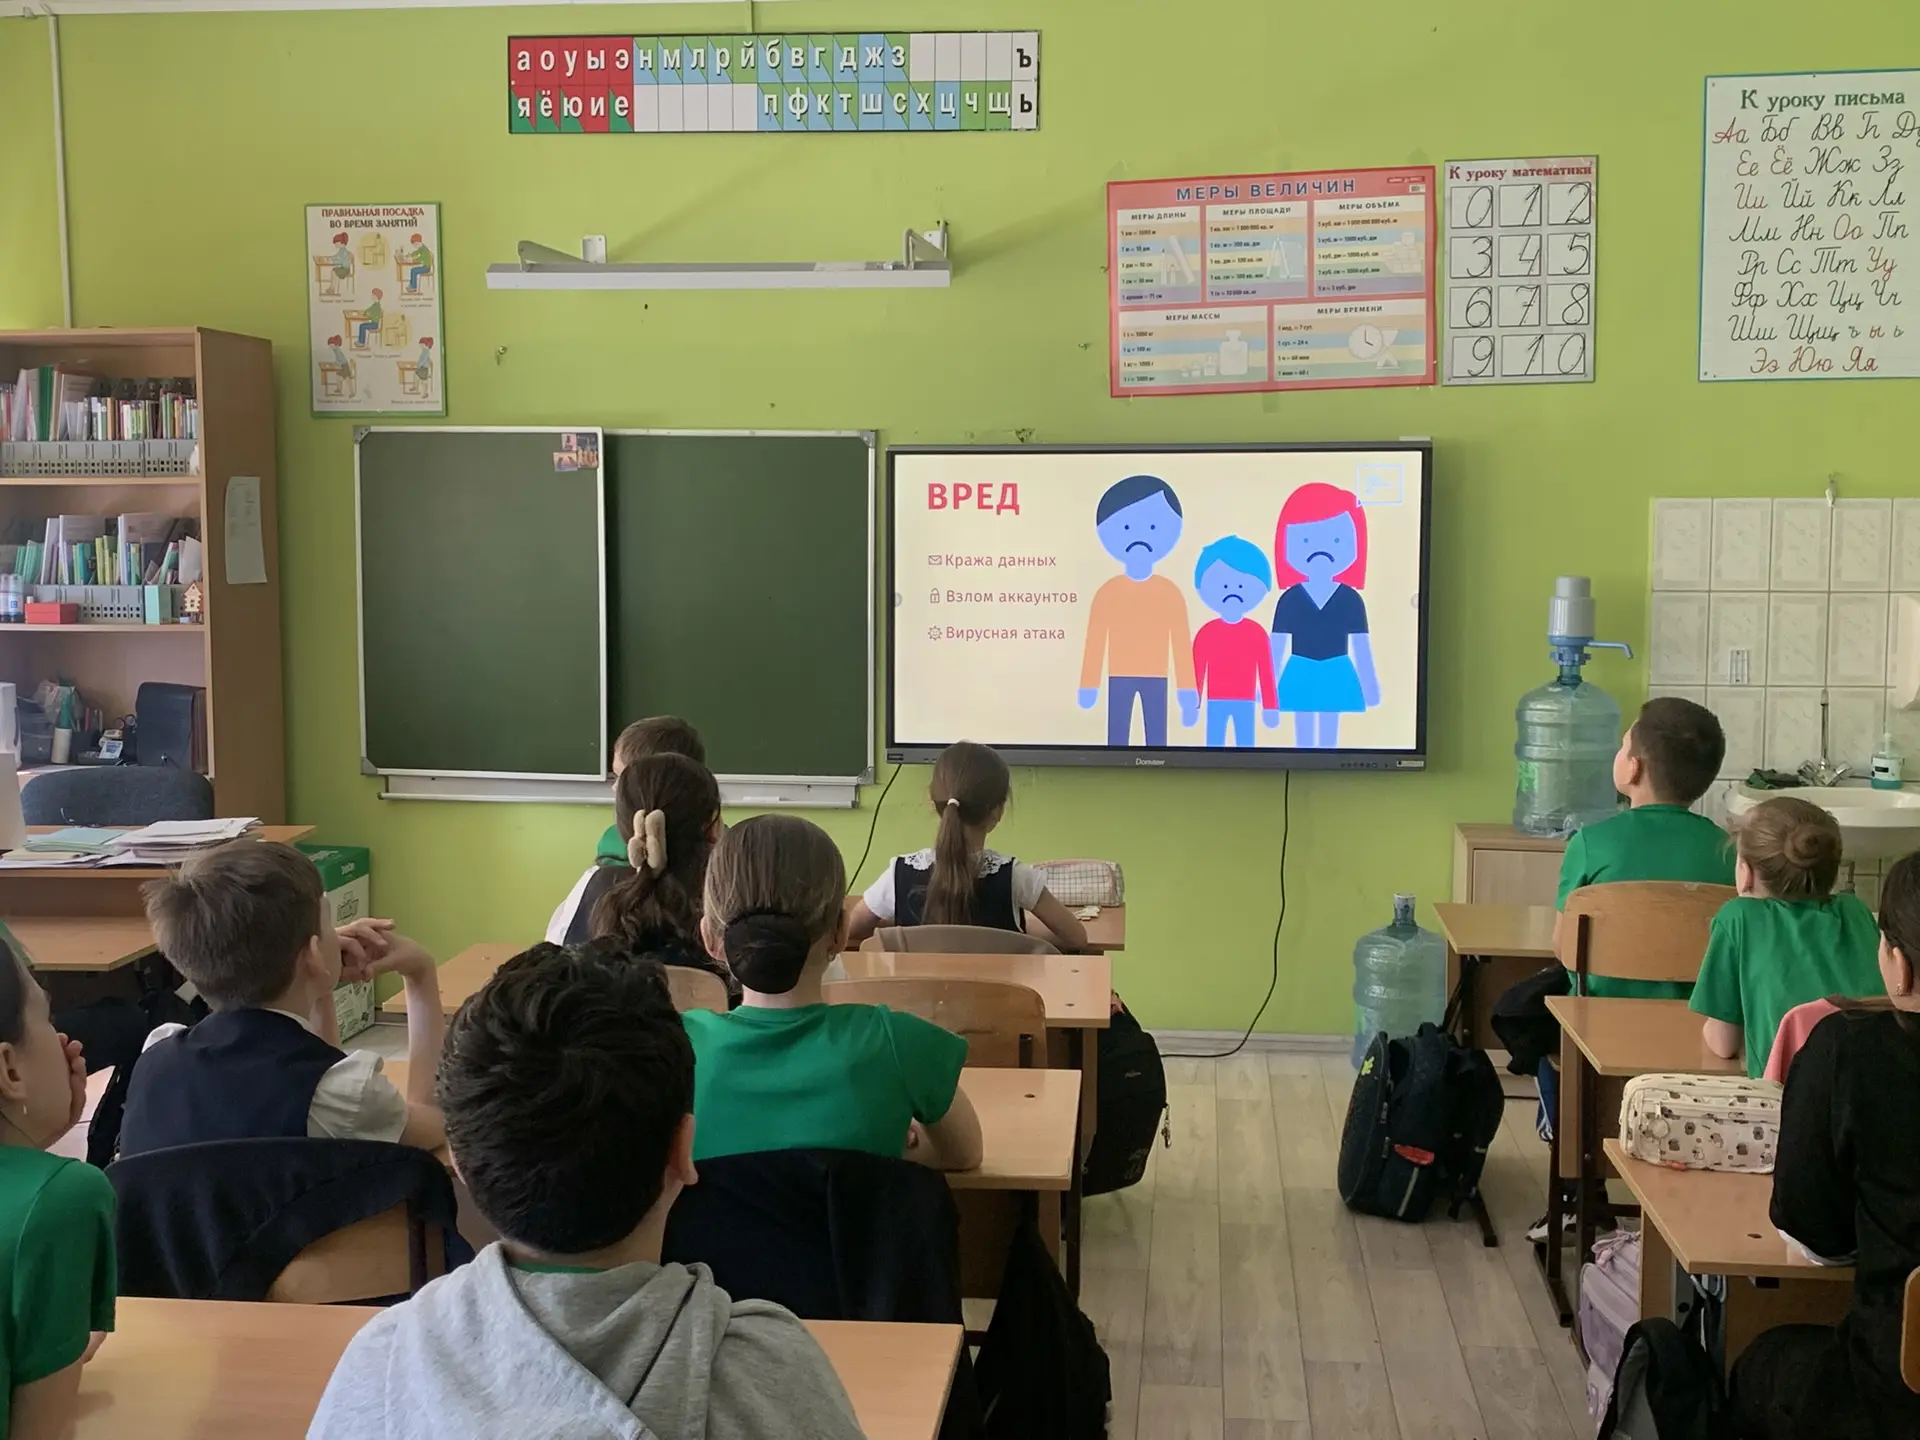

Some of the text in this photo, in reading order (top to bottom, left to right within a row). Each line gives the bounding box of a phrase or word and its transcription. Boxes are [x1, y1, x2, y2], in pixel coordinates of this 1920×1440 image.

[1741, 89, 1906, 112] К уроку письма
[1449, 165, 1592, 182] К уроку математики
[1176, 179, 1356, 201] МЕРЫ ВЕЛИЧИН
[321, 207, 424, 218] ПРАВИЛЬНАЯ ПОСАДКА
[1222, 206, 1291, 216] МЕРЫ ПЛОЩАДИ
[1338, 203, 1363, 211] МЕРЫ
[1466, 182, 1591, 228] 0 1 2
[330, 216, 418, 229] ВО ВРЕМЯ ЗАНЯТИЙ
[1131, 211, 1187, 221] МЕРЫ ДЛИНЫ
[1466, 233, 1590, 278] 3 4 5
[1343, 306, 1382, 314] ВРЕМЕНИ
[1466, 283, 1589, 328] 6 7 8
[1468, 336, 1494, 377] 9
[928, 483, 1020, 515] ВРЕД
[945, 554, 1056, 569] Кража данных
[946, 590, 1078, 606] Взлом аккаунтов
[946, 626, 1065, 641] Вирусная атака
